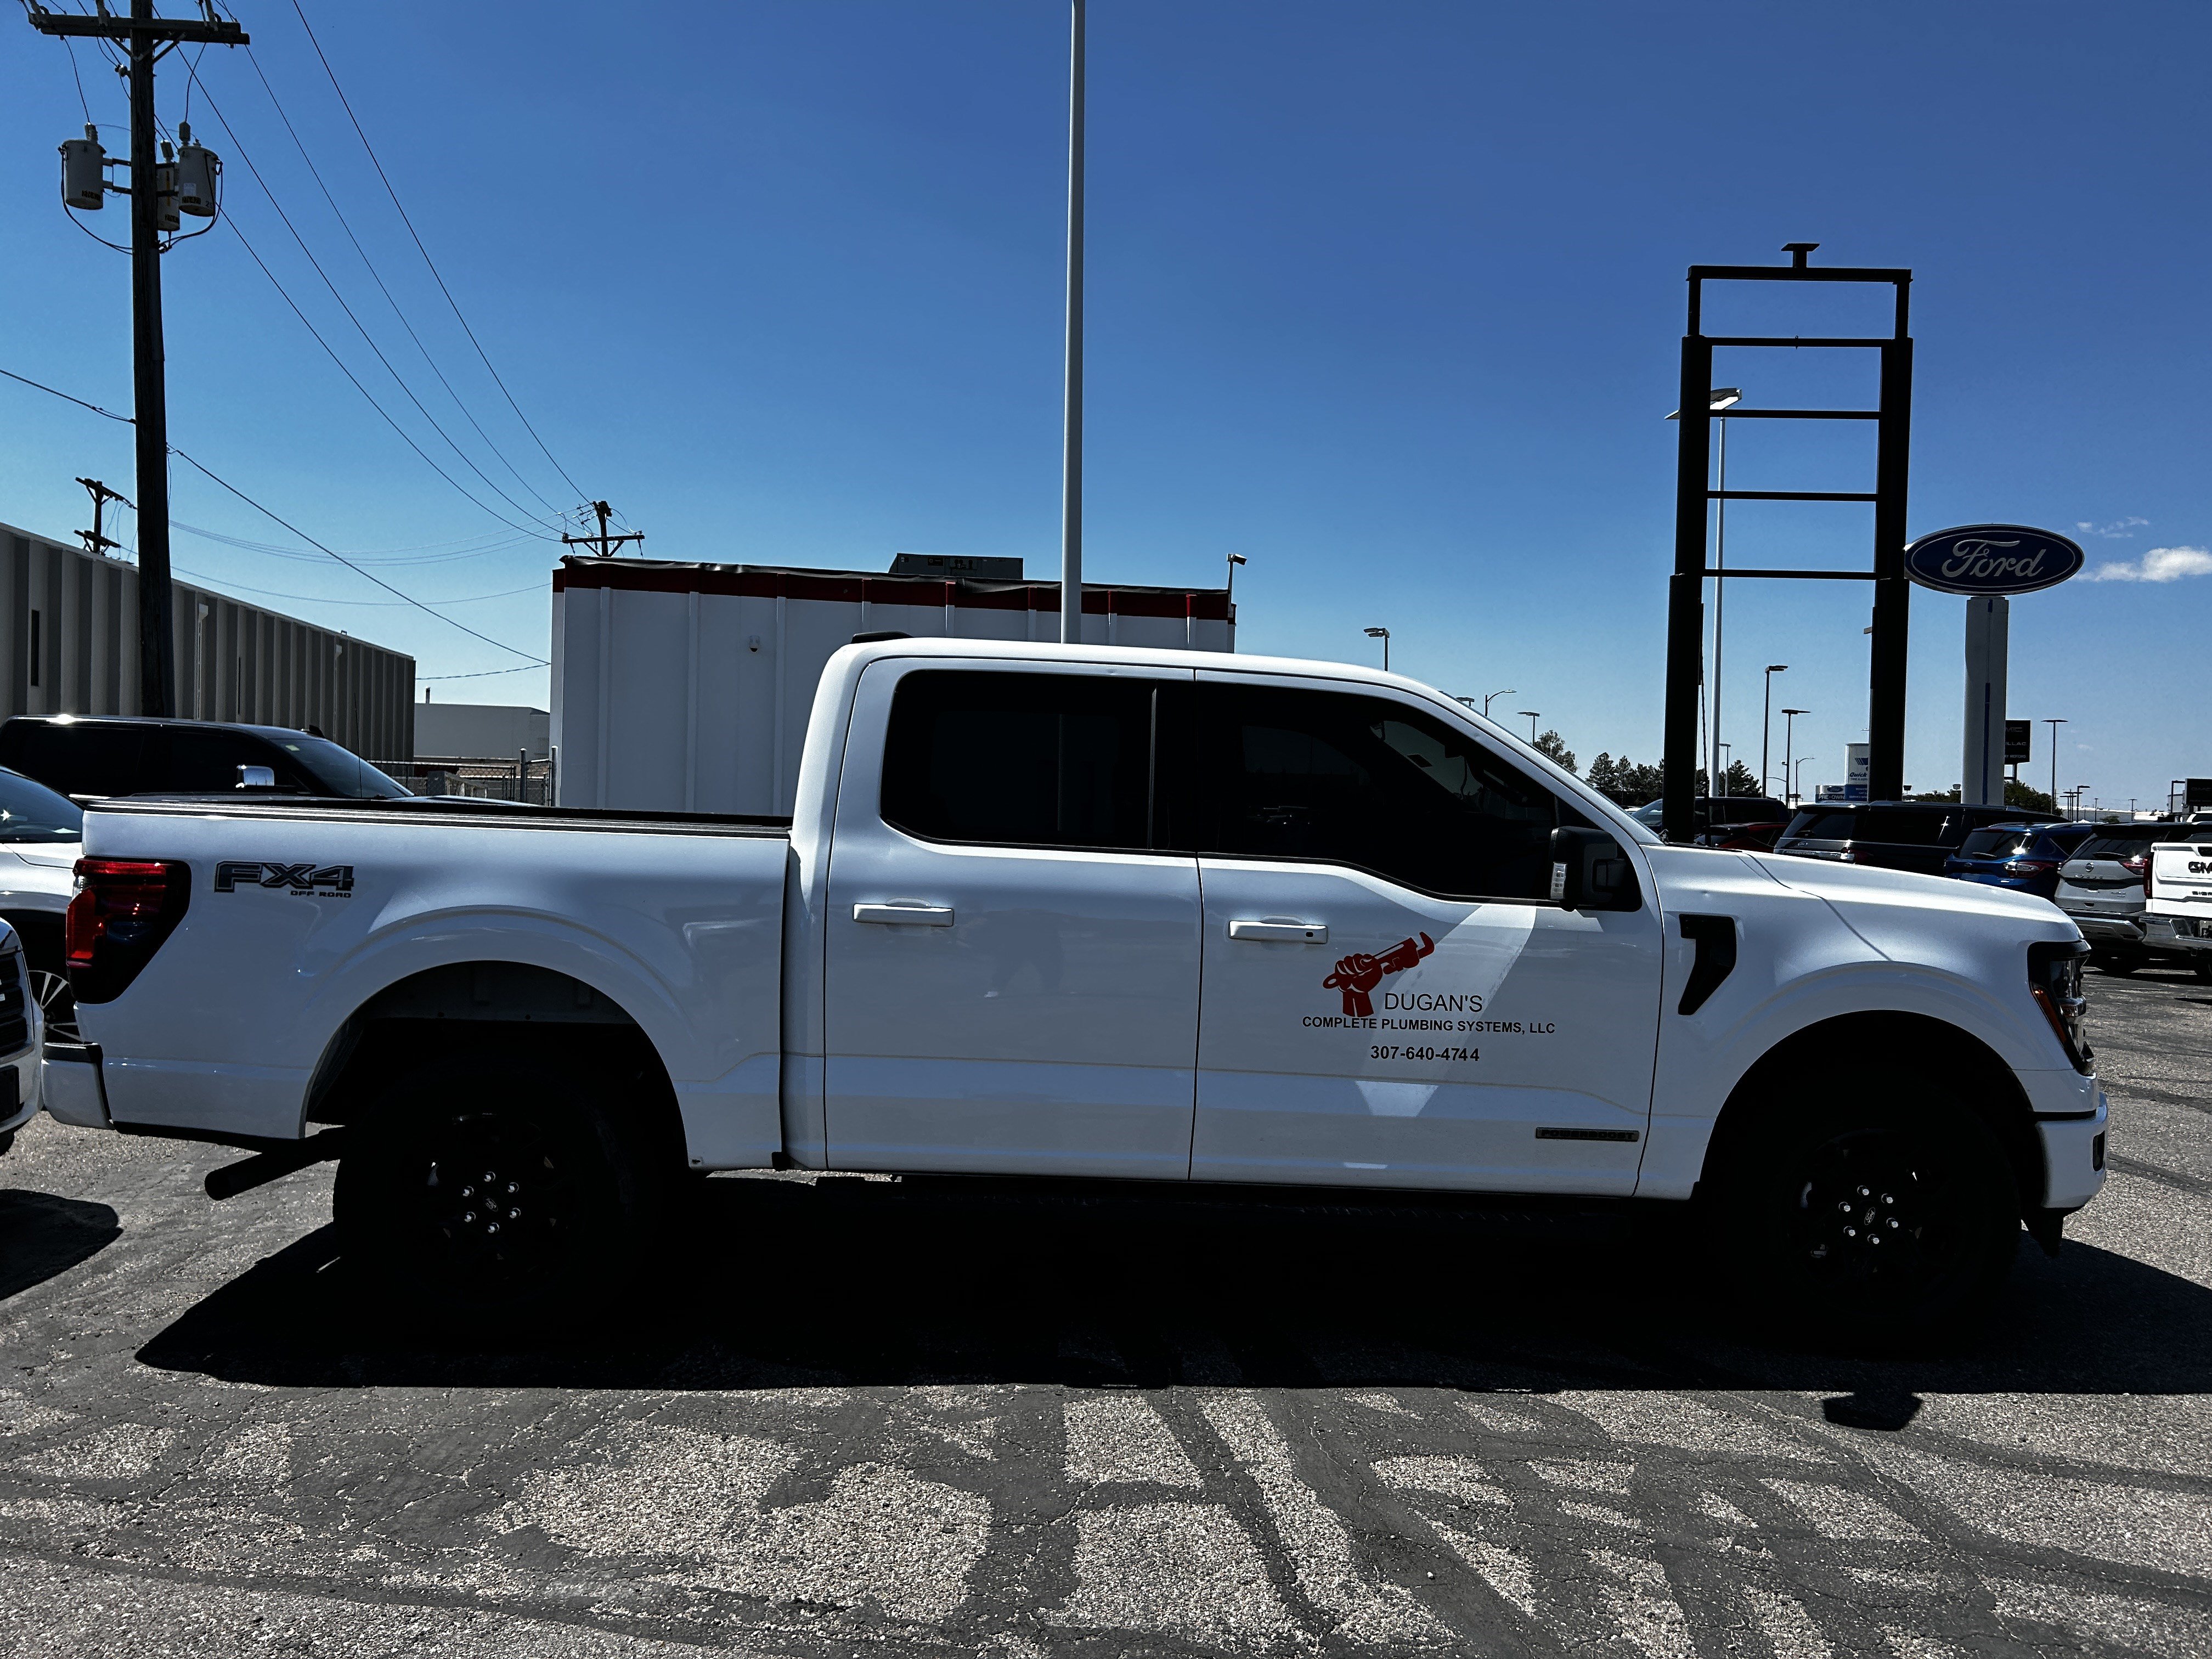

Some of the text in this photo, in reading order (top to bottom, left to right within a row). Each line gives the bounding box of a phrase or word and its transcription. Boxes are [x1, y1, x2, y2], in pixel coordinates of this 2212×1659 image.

[1942, 539, 2046, 577] Ford
[214, 861, 354, 893] FX4
[1385, 992, 1483, 1013] DUGAN'S
[1302, 1016, 1555, 1035] COMPLETE PLUMBING SYSTEMS, LLC
[1370, 1045, 1480, 1062] 307-640-4744
[1541, 1129, 1635, 1139] POWERBOOST
